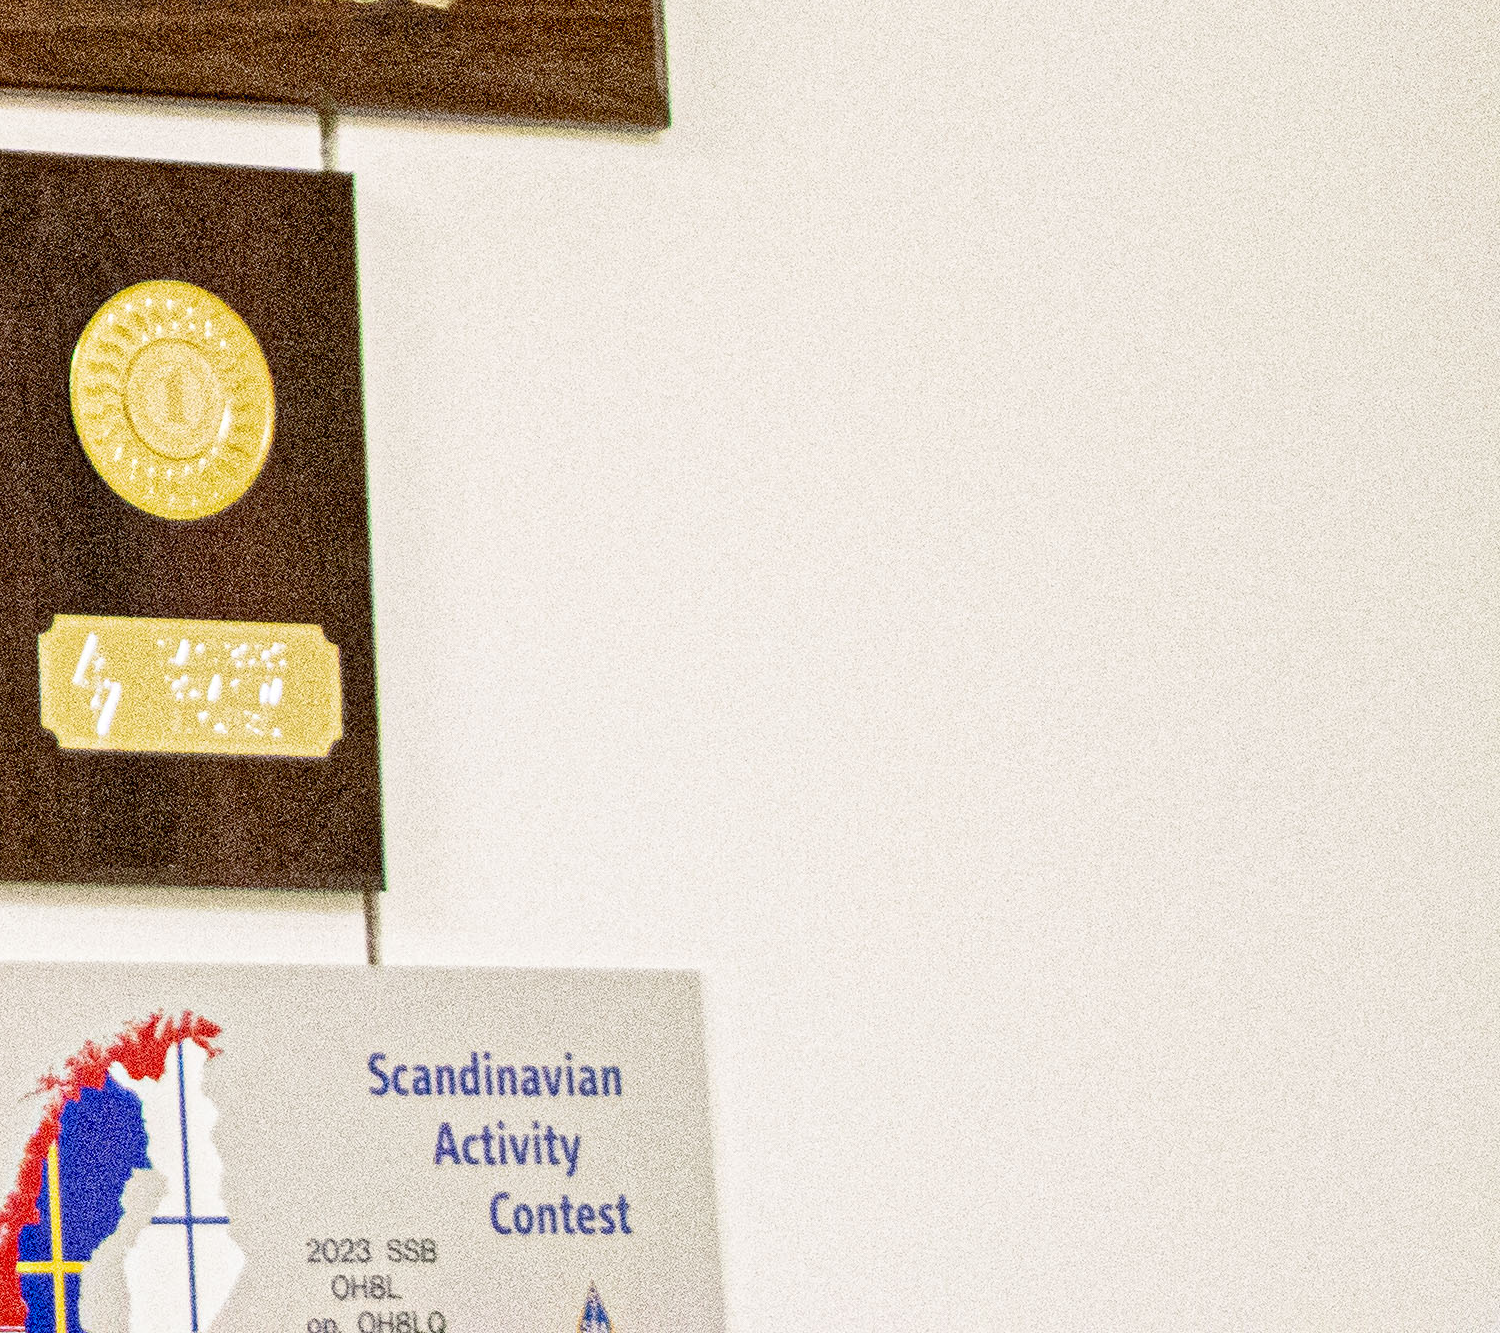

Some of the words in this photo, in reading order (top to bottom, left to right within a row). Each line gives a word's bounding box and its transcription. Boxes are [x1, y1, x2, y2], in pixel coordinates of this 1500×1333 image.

[366, 1052, 624, 1100] Scandinavian
[433, 1122, 581, 1178] Activity
[488, 1191, 633, 1237] Contest
[306, 1238, 372, 1265] 2023
[386, 1238, 438, 1264] SSB
[330, 1274, 402, 1301] OH8L
